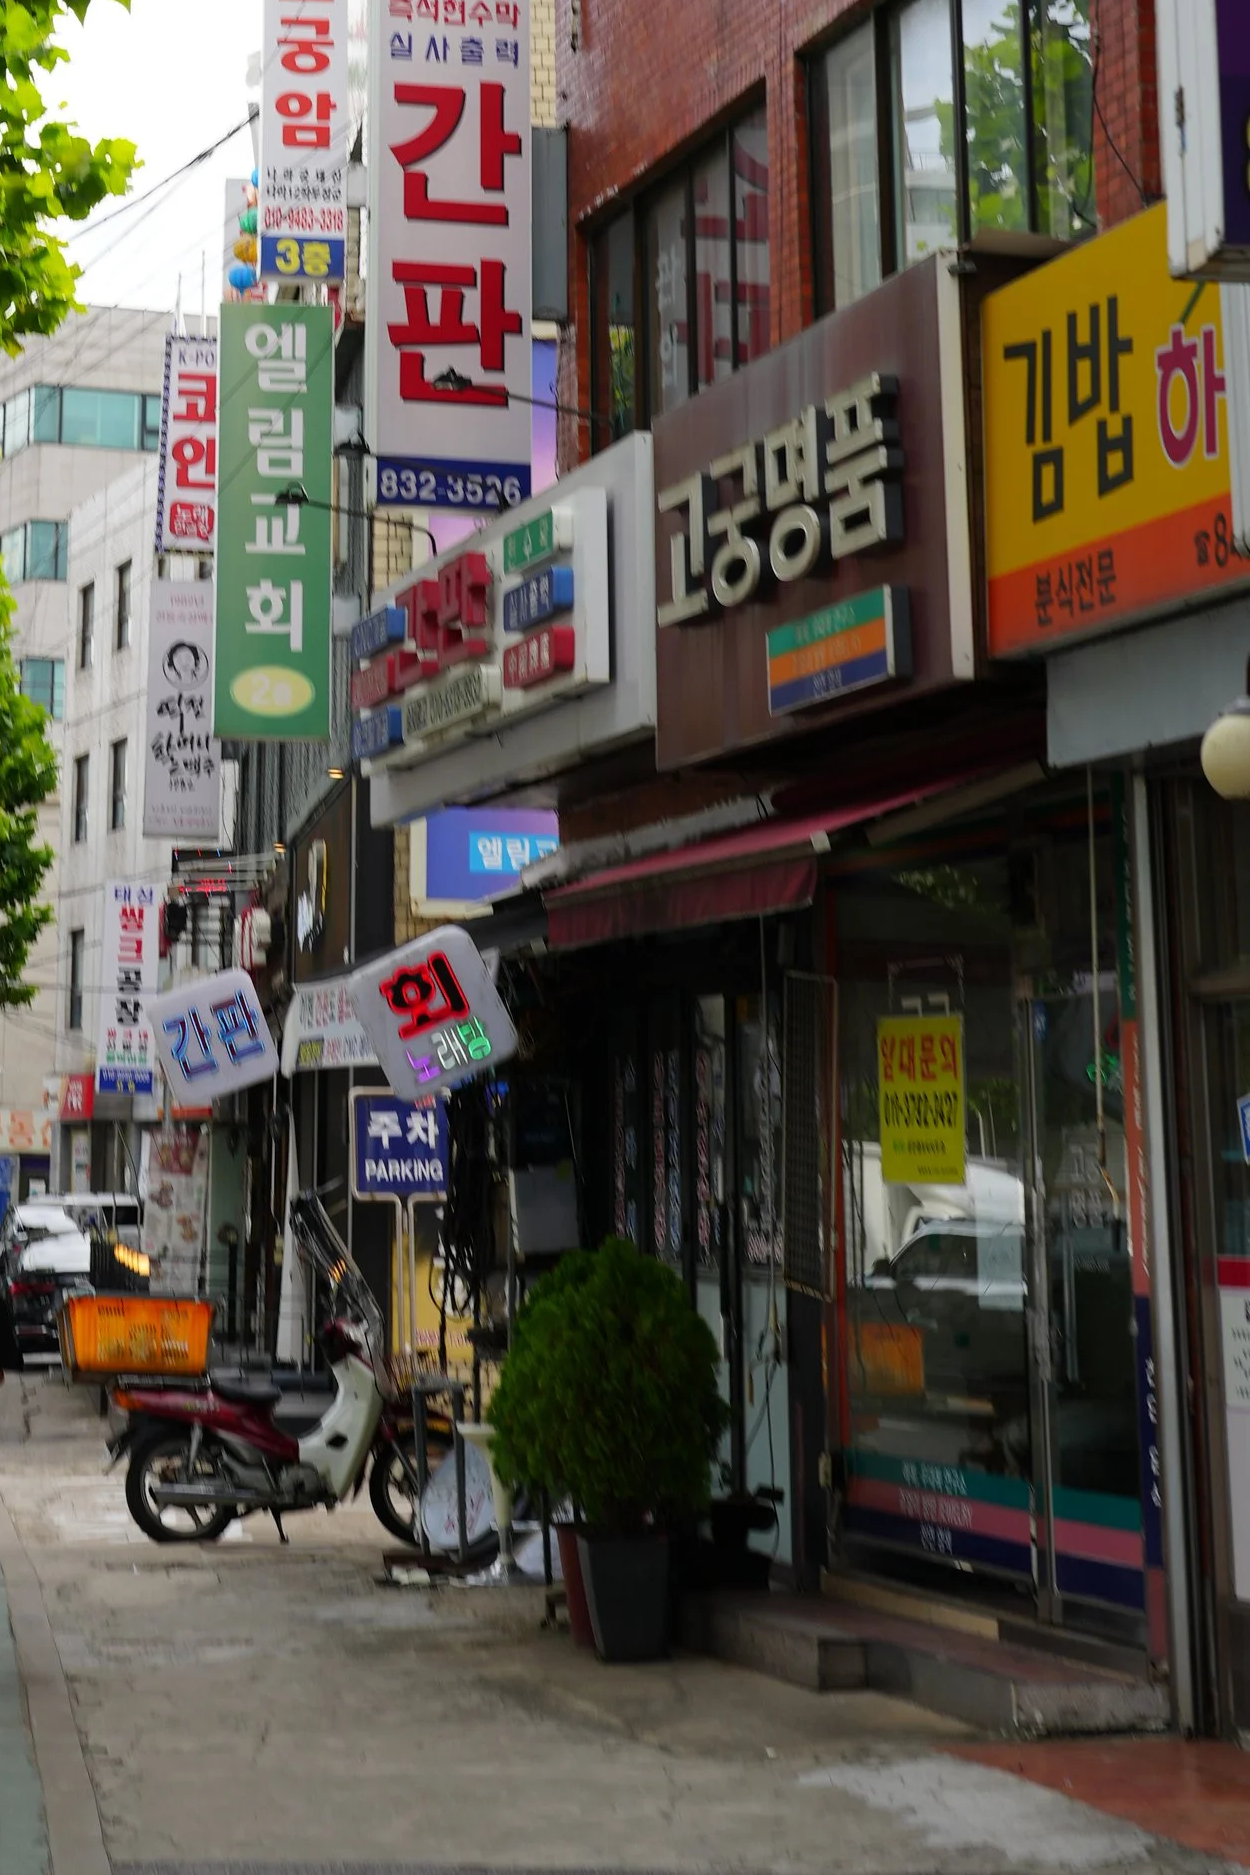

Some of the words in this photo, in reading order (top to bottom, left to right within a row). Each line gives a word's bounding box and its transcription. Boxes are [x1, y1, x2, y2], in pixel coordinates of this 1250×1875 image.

[390, 31, 519, 68] 실사출력
[275, 238, 331, 276] 3층
[387, 80, 523, 410] 간판
[171, 372, 216, 489] 코인
[1003, 293, 1135, 525] 김밥
[244, 323, 307, 653] 엘림교회
[380, 468, 522, 506] 832-3526
[657, 371, 899, 629] 고궁명품
[1034, 548, 1117, 627] 분식전문
[162, 988, 267, 1083] 간판
[405, 1014, 492, 1085] 노래방
[367, 1110, 440, 1150] 주차
[364, 1158, 444, 1183] PARKING
